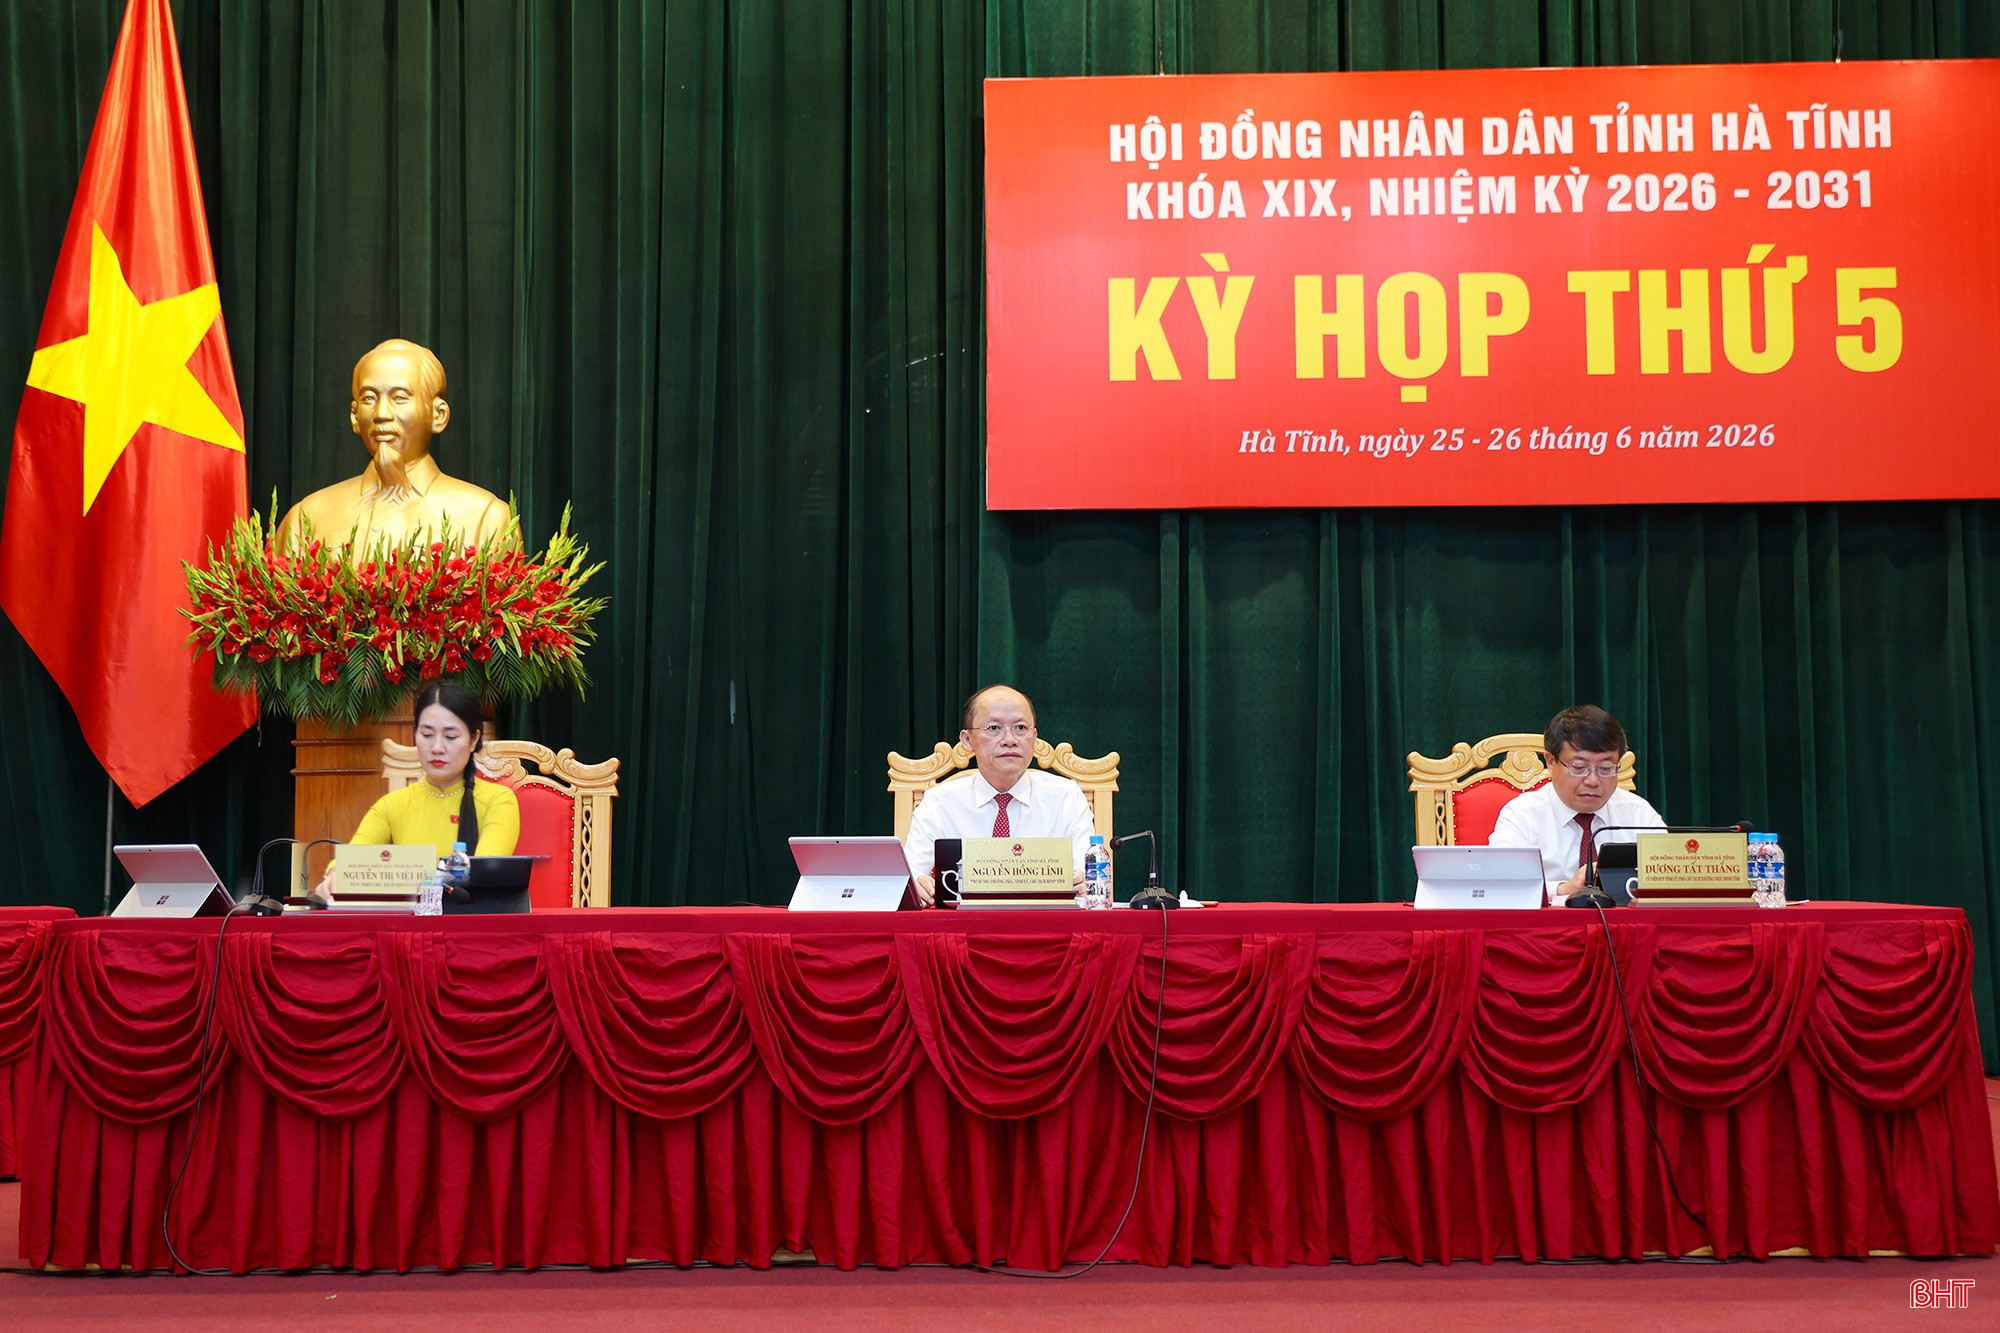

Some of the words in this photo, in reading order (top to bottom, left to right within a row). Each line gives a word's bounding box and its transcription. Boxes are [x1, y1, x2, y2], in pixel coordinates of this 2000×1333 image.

[1109, 115, 1183, 170] HỘI
[1198, 108, 1323, 161] ĐỒNG
[1339, 110, 1465, 159] NHÂN
[1481, 108, 1574, 156] DÂN
[1589, 101, 1694, 154] TỈNH
[1711, 103, 1772, 152] HÀ
[1785, 103, 1892, 150] TĨNH
[1126, 172, 1246, 222] KHÓA
[1260, 178, 1353, 225] XIX,
[1367, 168, 1517, 225] NHIỆM
[1533, 166, 1590, 214] KỲ
[1606, 172, 1717, 213] 2026
[1733, 188, 1750, 199] -
[1767, 169, 1872, 210] 2031
[1107, 251, 1256, 382] KỲ
[1293, 271, 1531, 403] HỌP
[1567, 243, 1808, 375] THỨ
[1835, 267, 1903, 373] 5
[1238, 428, 1276, 453] Hà
[1284, 428, 1351, 457] Tĩnh,
[1358, 427, 1425, 459] ngày
[1430, 427, 1465, 451] 25
[1487, 427, 1522, 451] 26
[1529, 425, 1609, 456] tháng
[1615, 425, 1632, 449] 6
[1638, 424, 1699, 449] năm
[1705, 423, 1775, 448] 2026
[343, 868, 377, 880] NGUYỄN
[379, 871, 394, 881] THỊ
[396, 869, 414, 881] VIỆT
[972, 863, 1010, 876] NGUYỄN
[1013, 863, 1038, 876] HỒNG
[1041, 865, 1063, 876] LĨNH
[1645, 863, 1680, 873] DƯƠNG
[1683, 860, 1703, 873] TẤT
[1705, 860, 1740, 873] THẮNG
